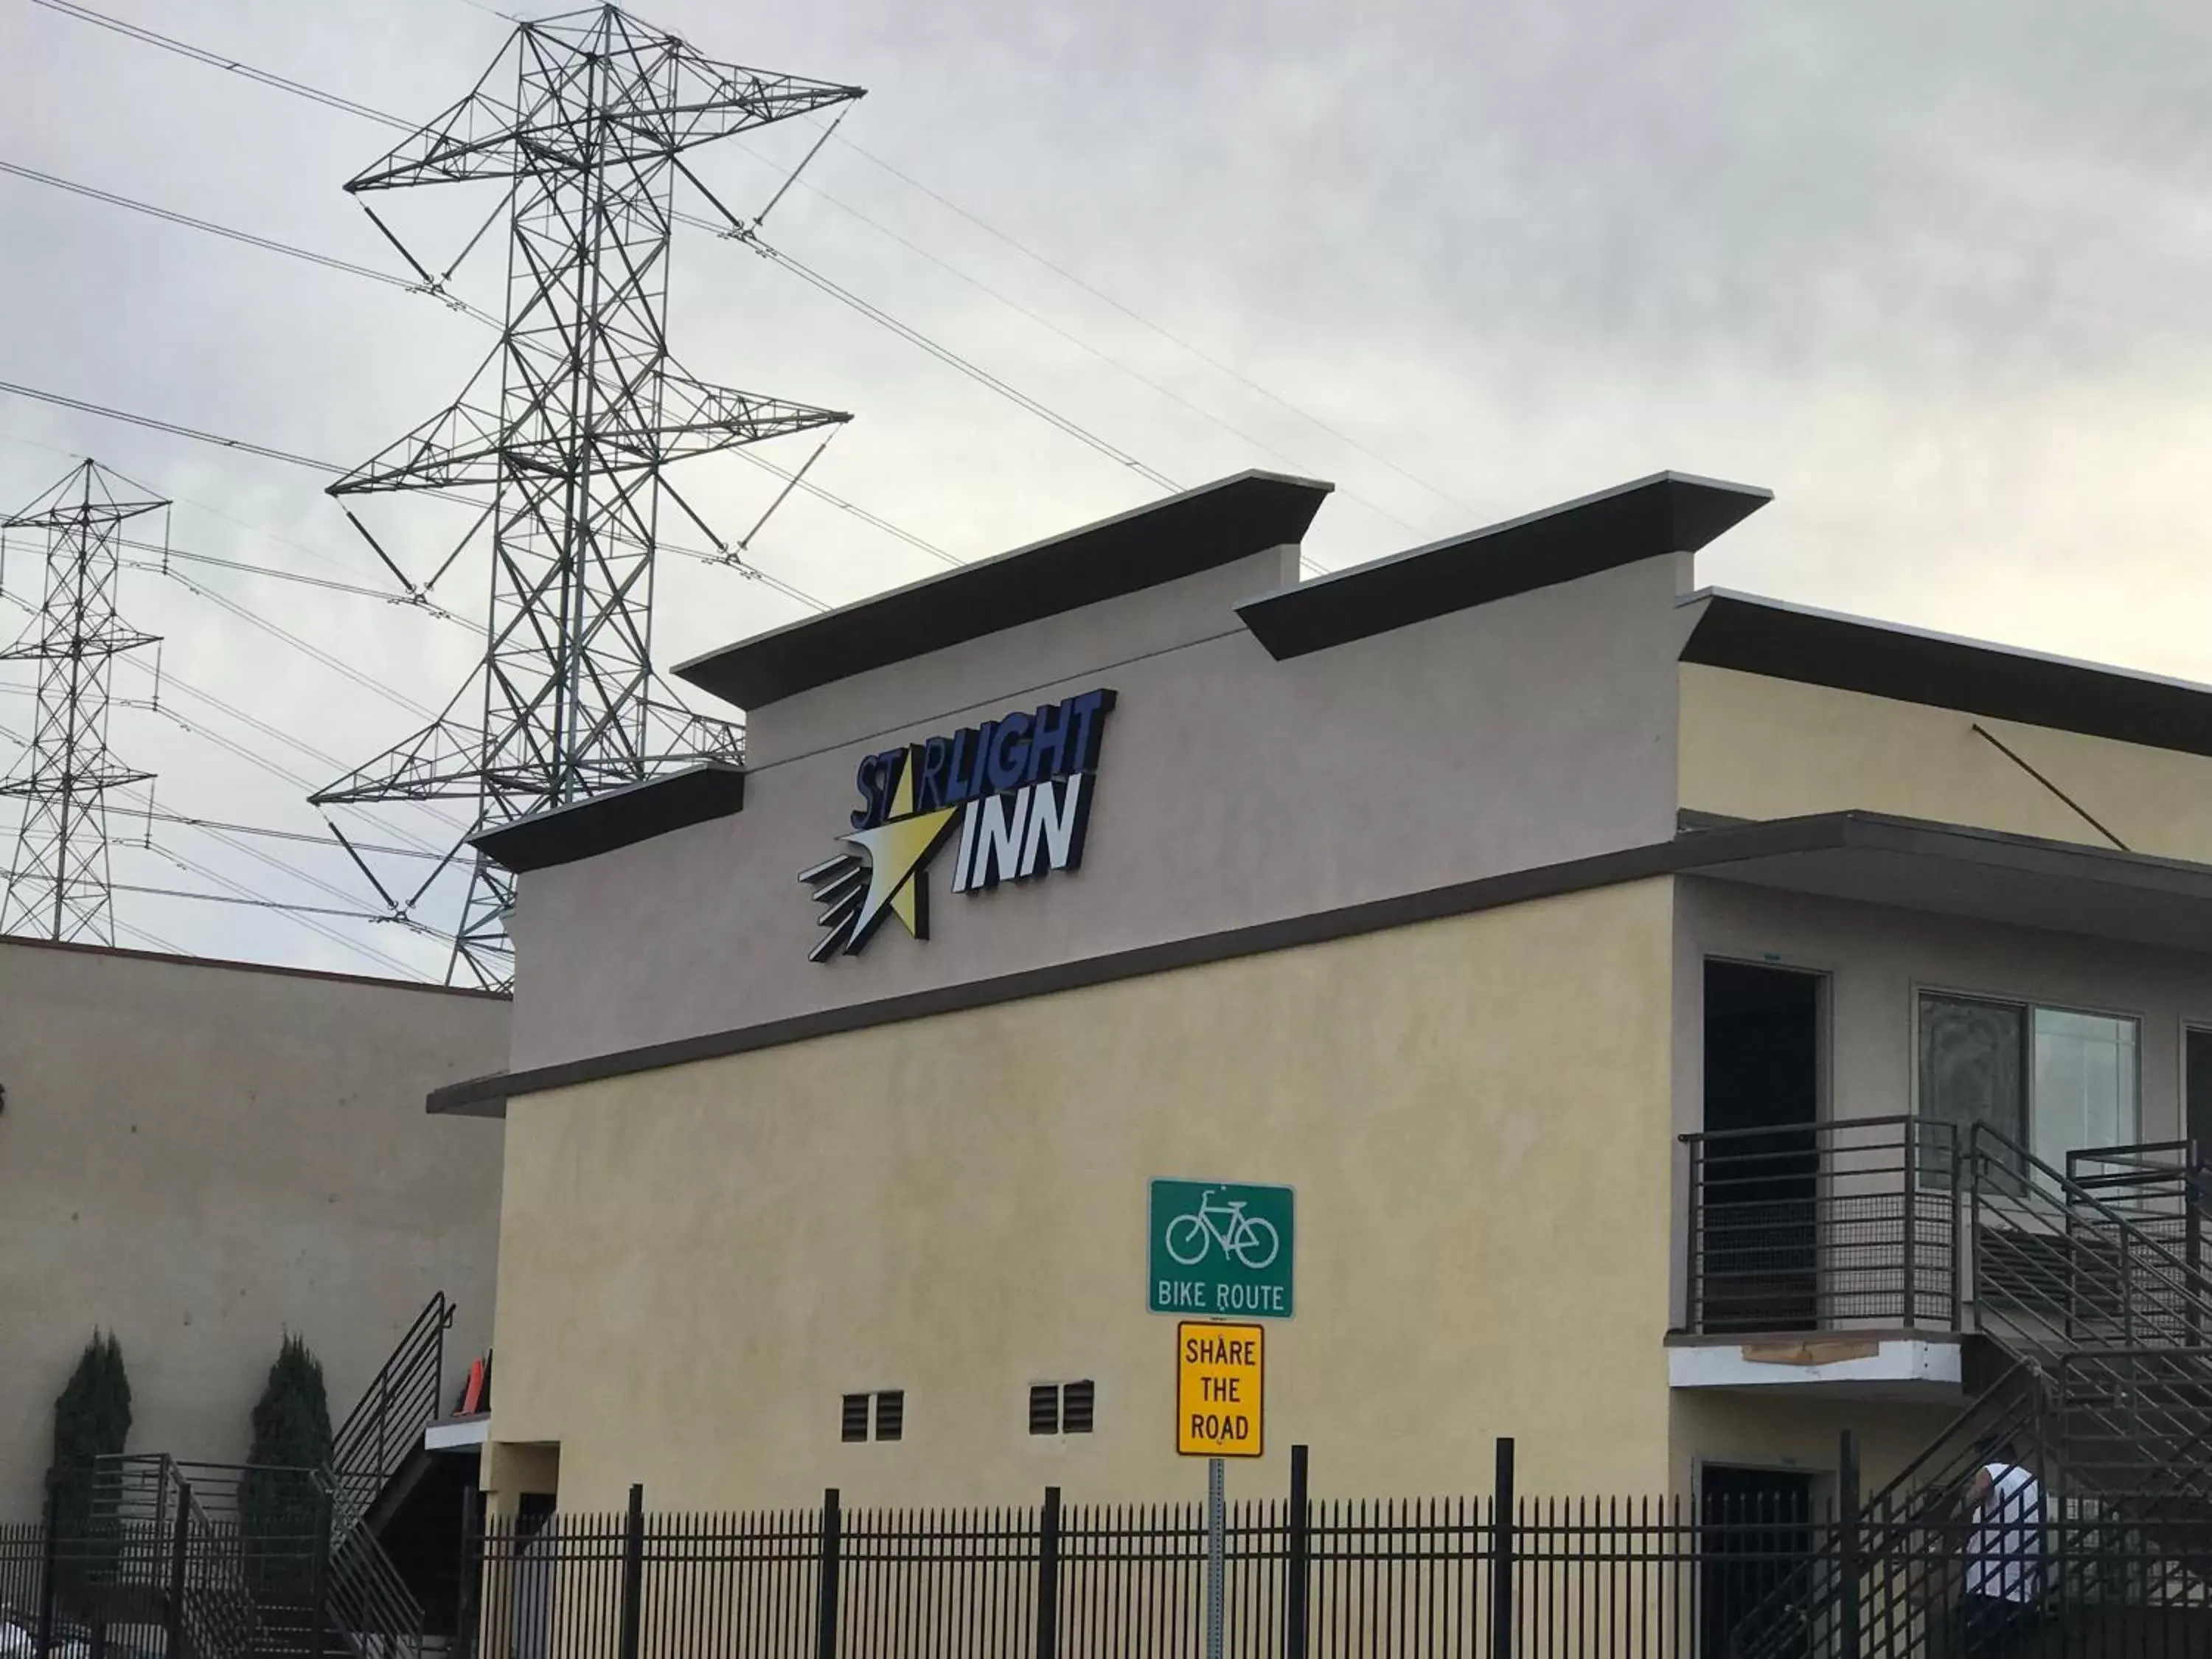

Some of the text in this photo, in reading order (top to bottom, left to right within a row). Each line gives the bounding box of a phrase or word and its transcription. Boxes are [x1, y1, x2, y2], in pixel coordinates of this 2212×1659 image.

[850, 688, 1116, 830] STARLIGHT
[951, 772, 1088, 894] INN
[1158, 1280, 1284, 1311] BIKE ROUTE
[1185, 1338, 1256, 1366] SHARE
[1200, 1377, 1241, 1402] THE
[1191, 1413, 1249, 1440] ROAD
